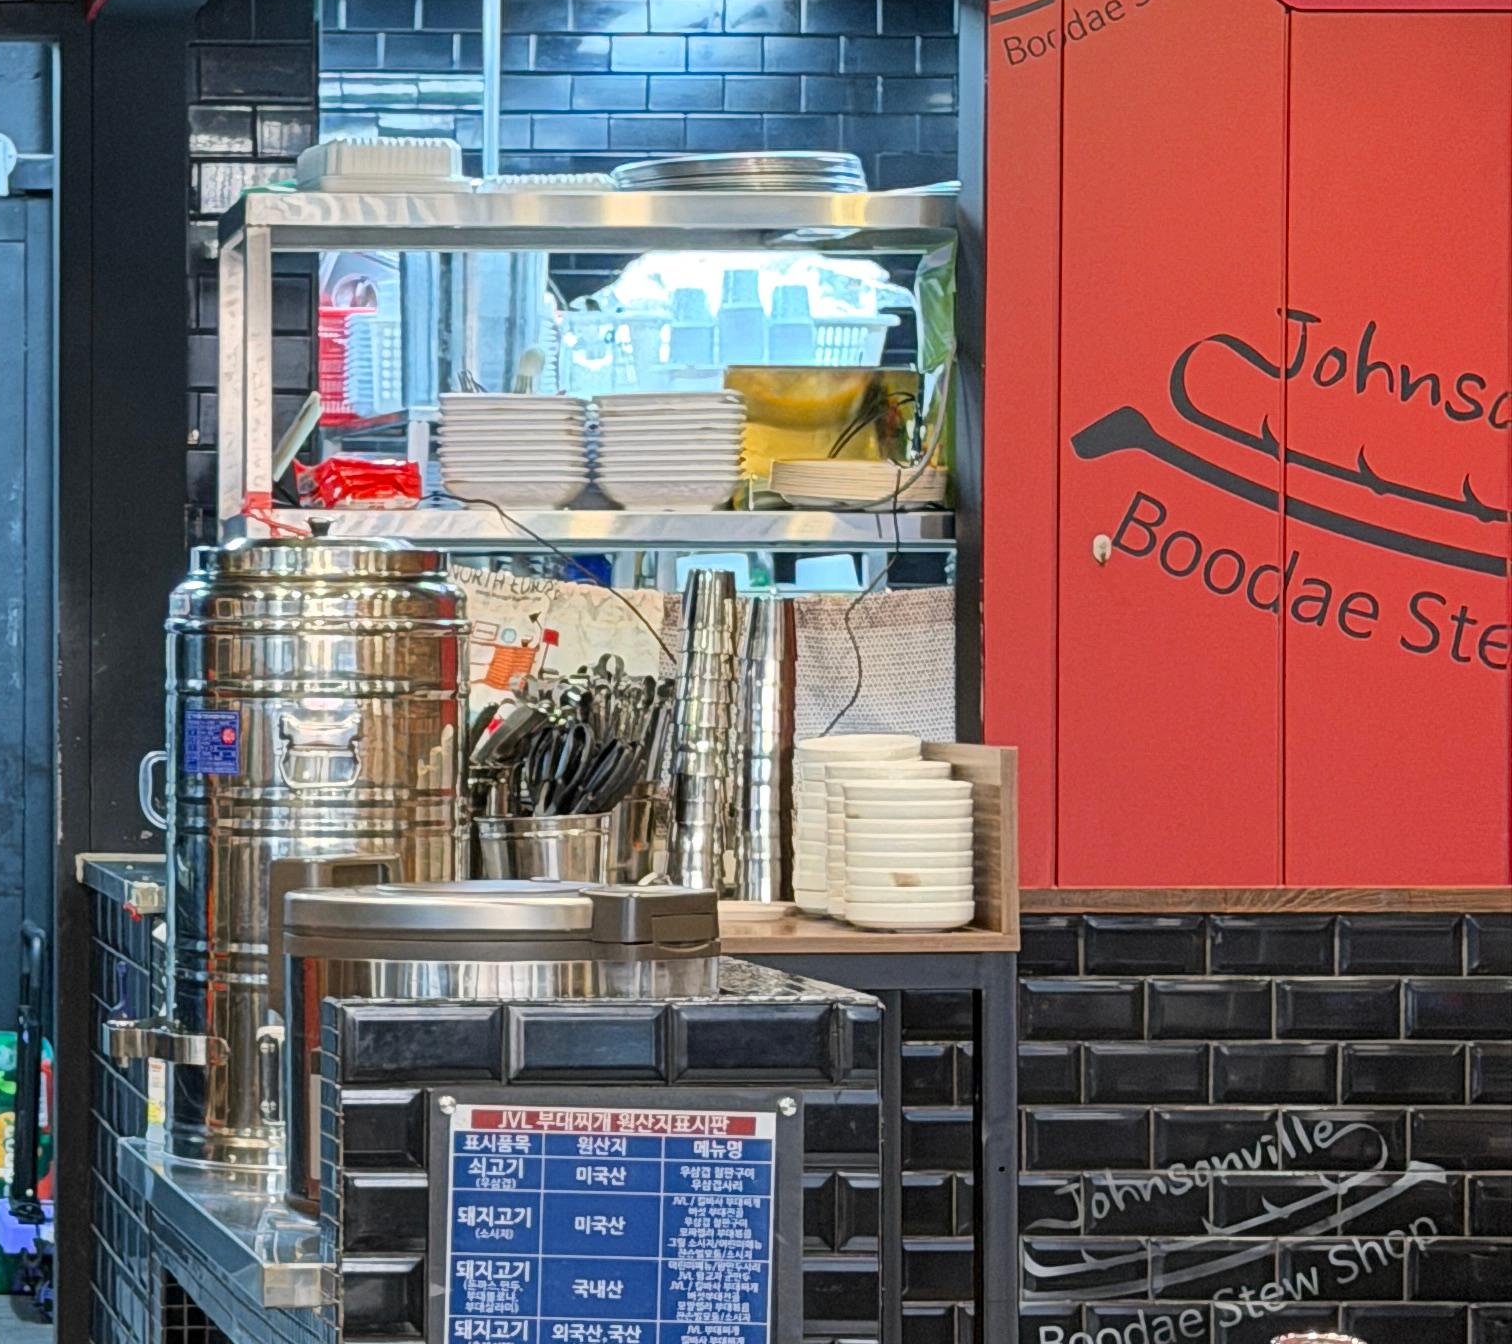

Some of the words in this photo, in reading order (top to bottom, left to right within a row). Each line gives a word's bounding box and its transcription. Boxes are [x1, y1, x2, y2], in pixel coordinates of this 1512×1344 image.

[1111, 491, 1380, 639] Boodae
[498, 1111, 533, 1129] JVL
[536, 1111, 611, 1131] 부대찌개
[616, 1112, 730, 1135] 원산지표시판
[462, 1134, 531, 1153] 표시품목
[577, 1136, 627, 1156] 원산지
[693, 1140, 743, 1159] 메뉴명
[468, 1157, 524, 1179] 쇠고기
[576, 1166, 627, 1186] 미국산
[1028, 1116, 1338, 1229] Johnsonville
[457, 1206, 532, 1228] 돼지고기
[575, 1216, 626, 1236] 미국산
[456, 1259, 531, 1282] 돼지고기
[1213, 1265, 1319, 1328] Stew
[1328, 1215, 1438, 1285] Shop
[572, 1279, 624, 1299] 국내산
[454, 1318, 529, 1342] 돼지고기
